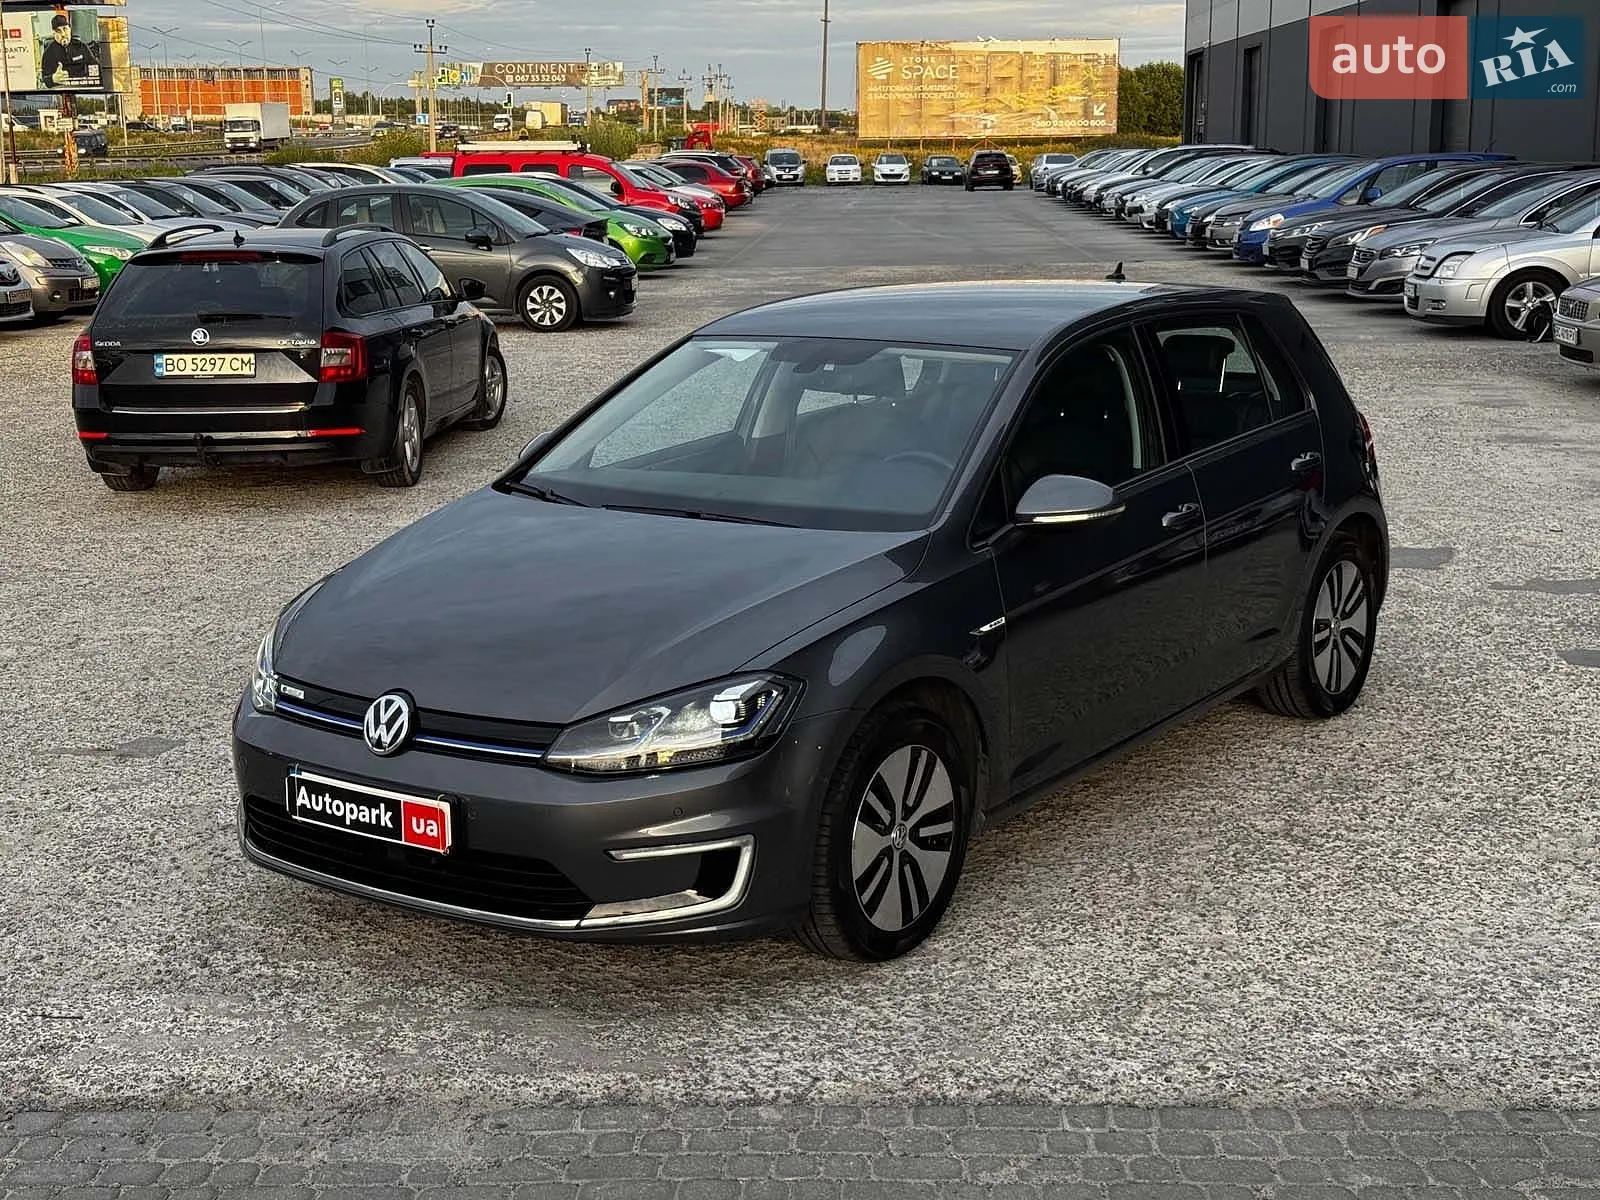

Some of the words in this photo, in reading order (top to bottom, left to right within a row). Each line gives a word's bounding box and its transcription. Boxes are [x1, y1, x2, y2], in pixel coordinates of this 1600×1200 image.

[495, 63, 575, 74] CONTINENT
[901, 64, 960, 80] SPACE
[515, 74, 530, 82] 067
[551, 74, 566, 82] 043
[165, 357, 187, 372] BO
[191, 356, 225, 372] 5297
[229, 356, 252, 371] CM
[297, 786, 393, 828] Autopark
[411, 815, 439, 838] ua
